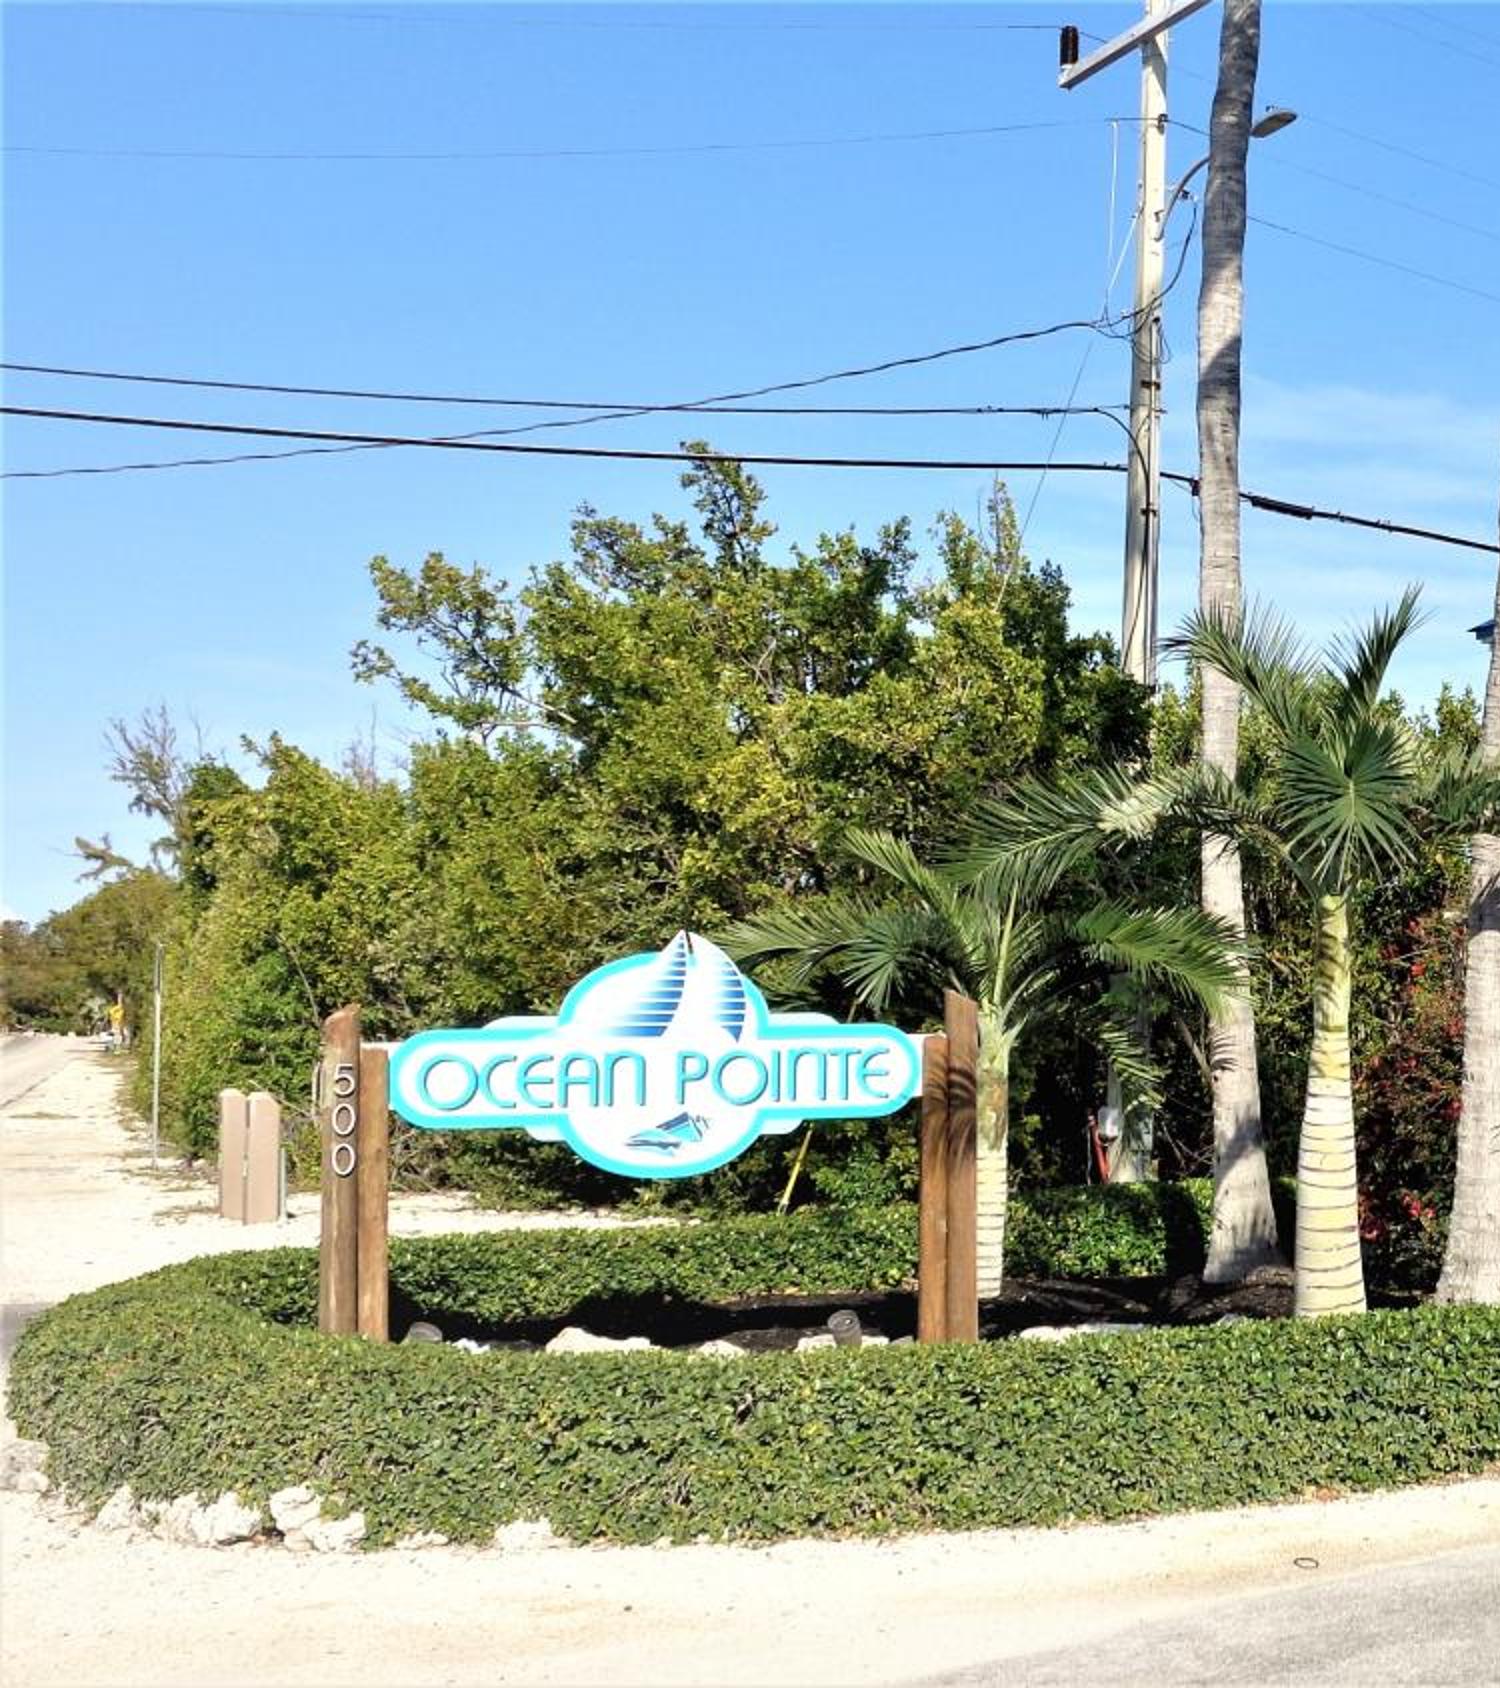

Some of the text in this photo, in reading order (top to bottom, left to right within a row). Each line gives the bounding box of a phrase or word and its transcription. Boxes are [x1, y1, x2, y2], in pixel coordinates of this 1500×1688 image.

[331, 1064, 356, 1176] 500
[416, 1048, 890, 1110] OCEAN POINTE
